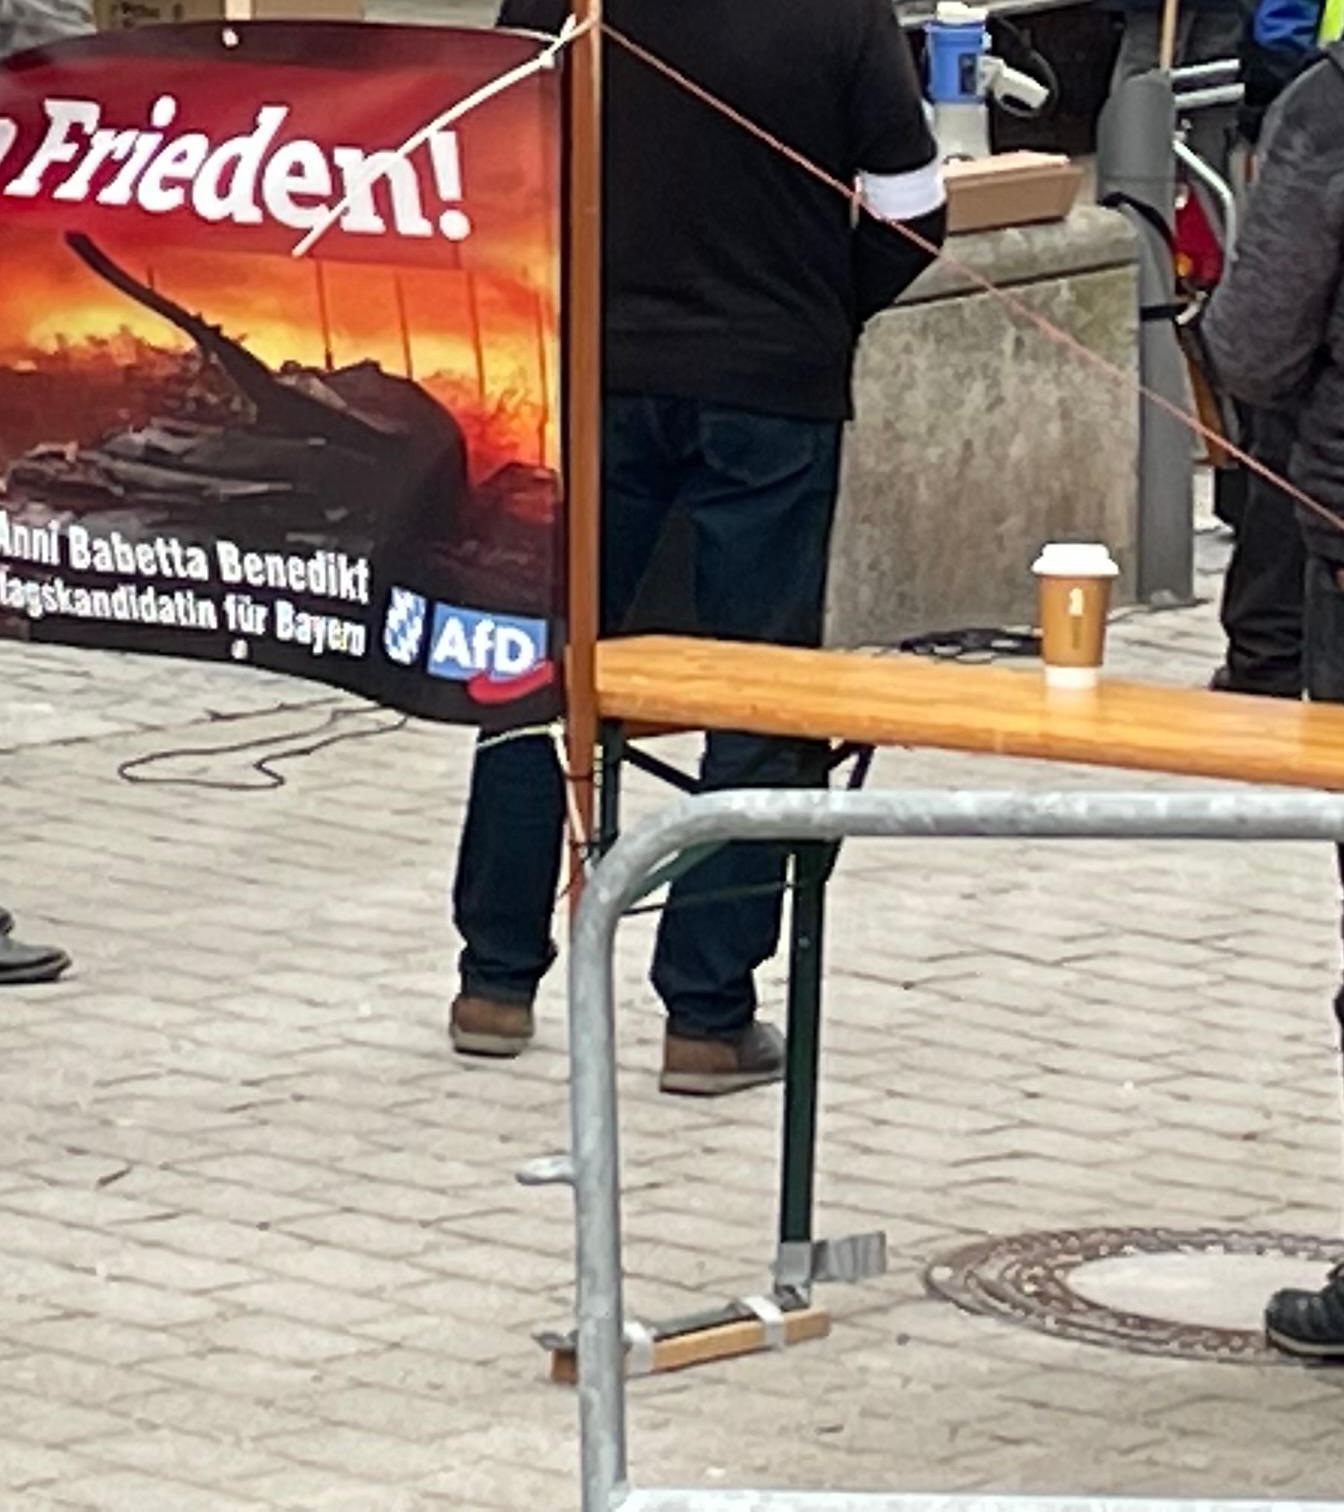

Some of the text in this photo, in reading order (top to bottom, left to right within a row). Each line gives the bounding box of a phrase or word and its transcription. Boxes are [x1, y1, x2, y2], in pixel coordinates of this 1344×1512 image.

[2, 95, 472, 241] Frieden!
[68, 524, 209, 581] Babetta
[216, 540, 371, 605] Benedikt
[223, 592, 270, 636] für
[275, 599, 367, 657] Bayern
[433, 616, 536, 674] AfD
